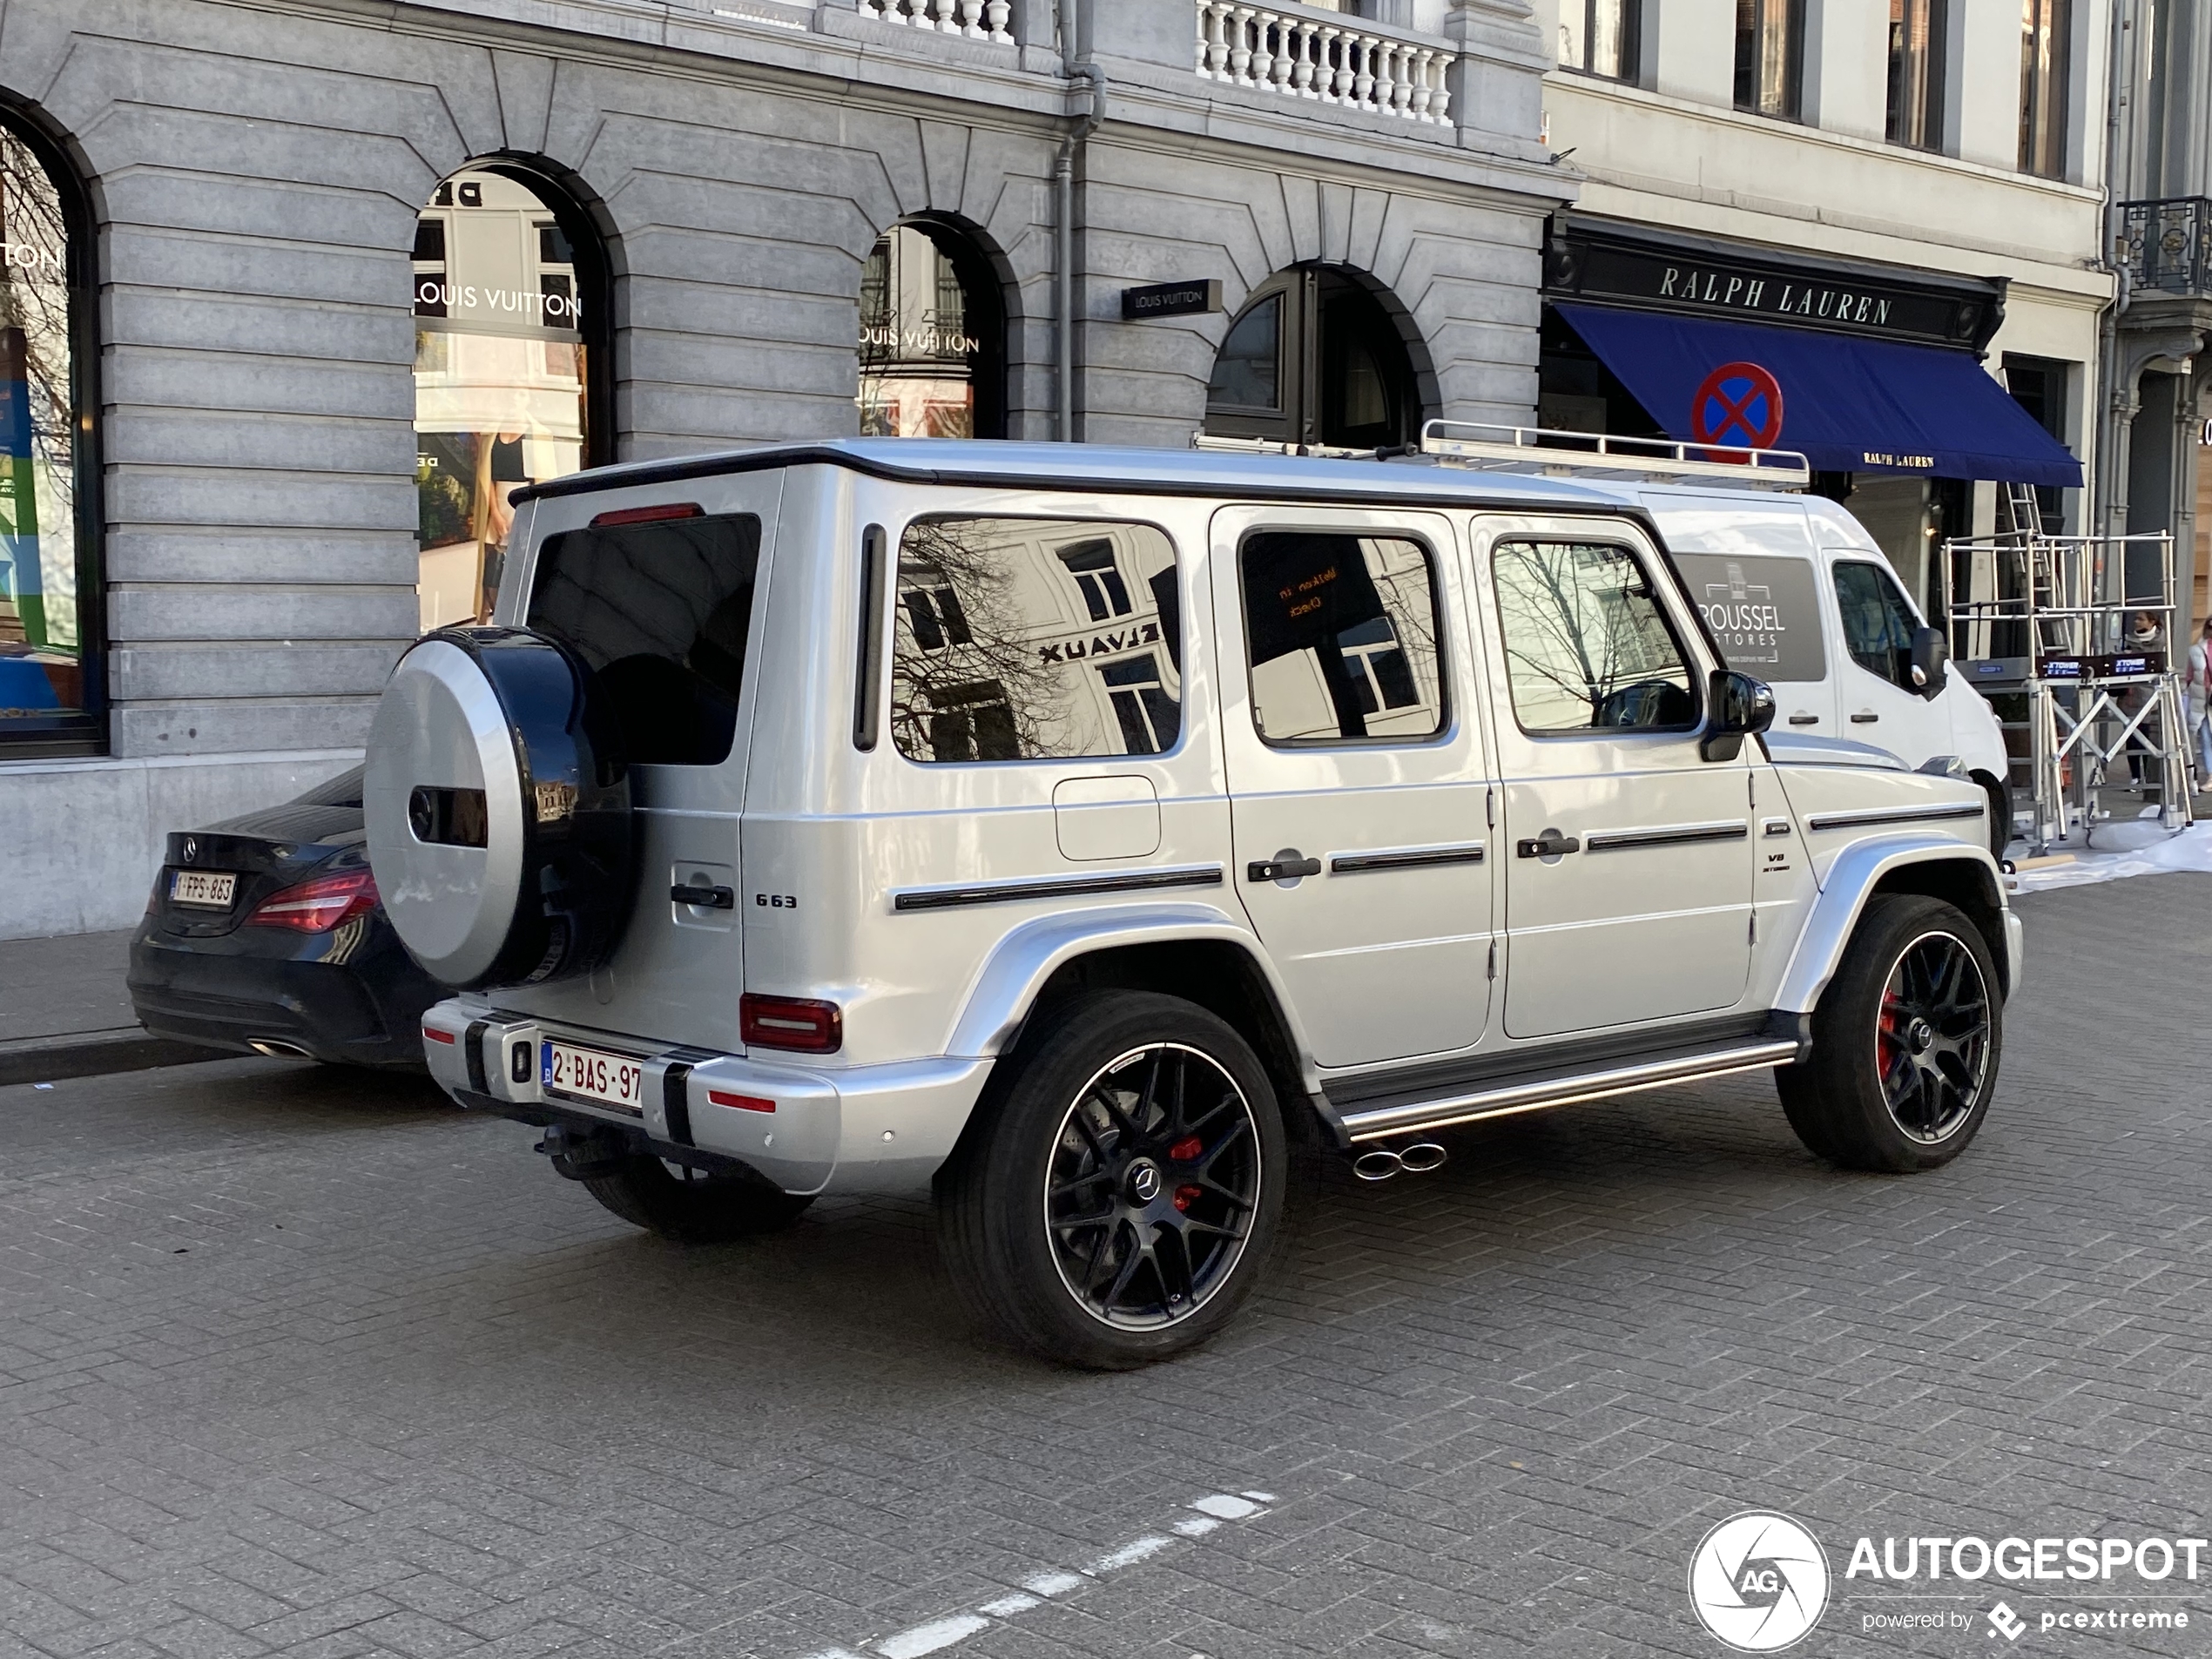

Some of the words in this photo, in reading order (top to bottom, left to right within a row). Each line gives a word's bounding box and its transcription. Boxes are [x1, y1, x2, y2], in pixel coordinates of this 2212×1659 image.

[484, 288, 582, 318] VUITTON
[1135, 294, 1162, 308] LOUIS
[1163, 290, 1203, 306] VUITTON
[1659, 267, 1765, 307] RALPH
[1778, 284, 1892, 325] LAUREN
[1864, 452, 1893, 466] RALPH
[1896, 455, 1934, 468] LAUREN
[1713, 633, 1777, 646] STORES
[1768, 853, 1784, 862] V8
[176, 875, 233, 900] 1-FPS-863
[553, 1051, 642, 1101] 2-BAS-97
